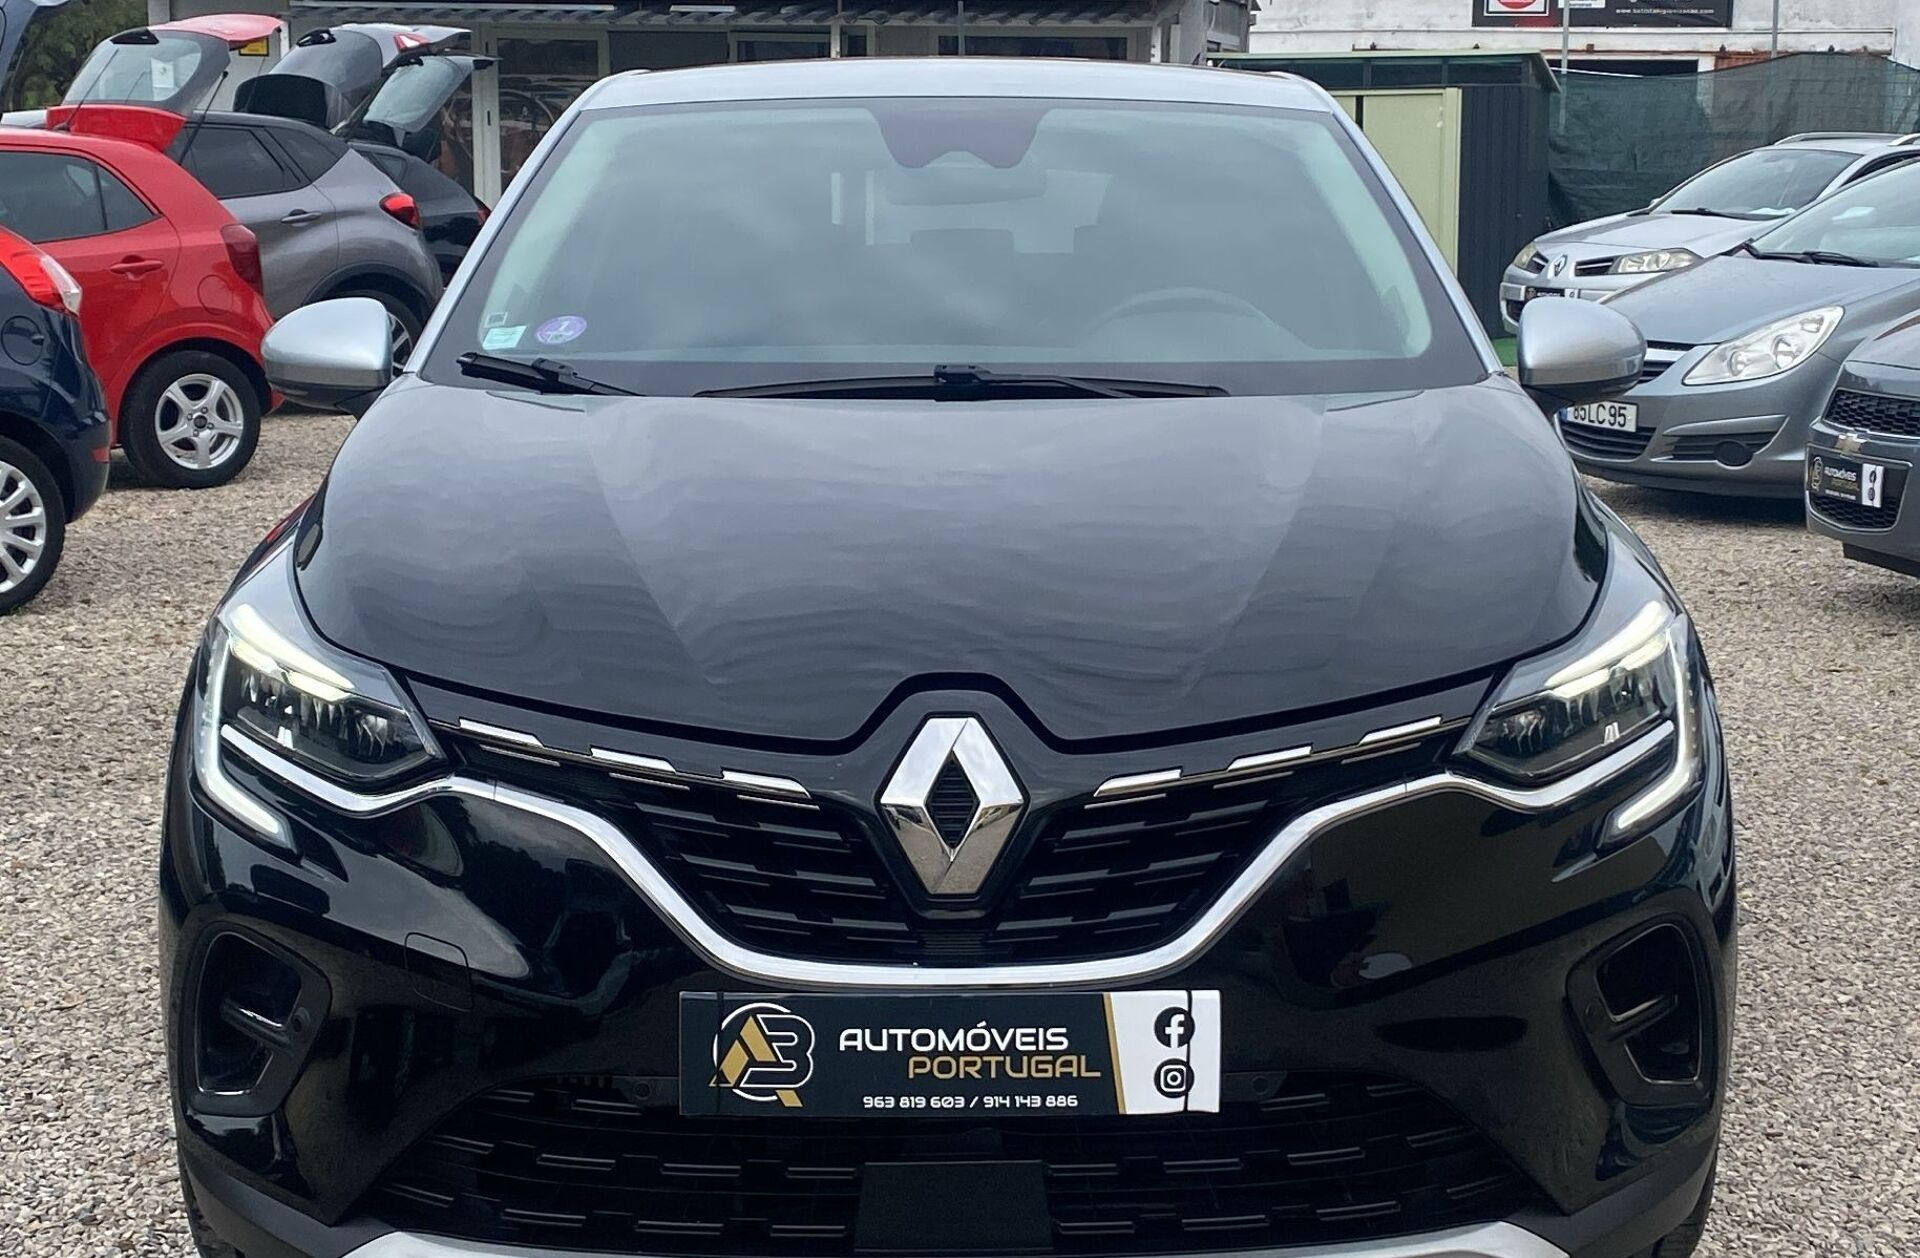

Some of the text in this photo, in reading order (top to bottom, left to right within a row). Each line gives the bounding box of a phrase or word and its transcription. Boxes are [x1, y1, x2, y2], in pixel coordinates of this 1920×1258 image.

[840, 1020, 1069, 1052] AUTOMÓVEIS
[908, 1055, 1101, 1079] PORTUGAL
[863, 1094, 1079, 1109] 963 819 603 / 914 143 886
